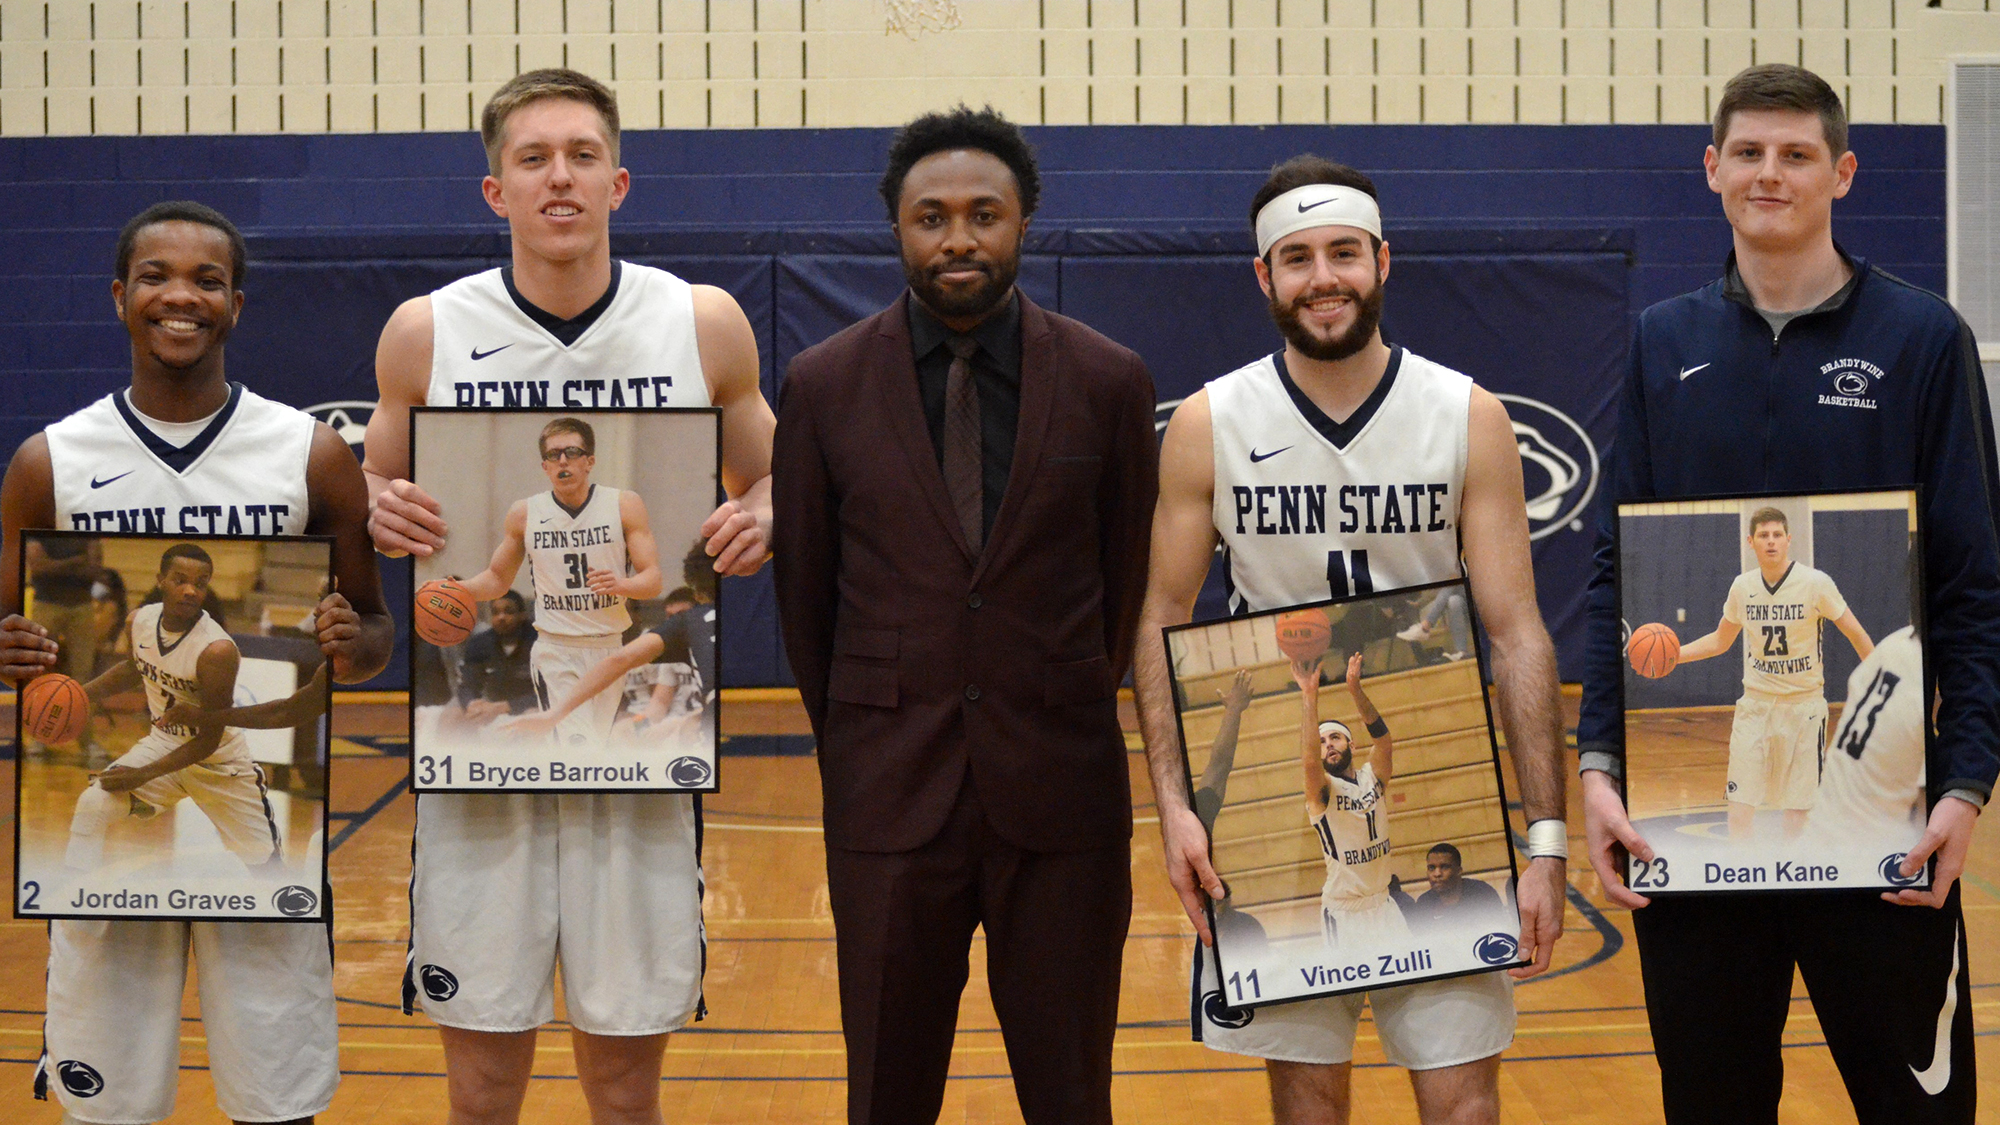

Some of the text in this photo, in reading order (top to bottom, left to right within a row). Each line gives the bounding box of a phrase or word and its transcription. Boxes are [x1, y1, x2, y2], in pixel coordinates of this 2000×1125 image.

[1820, 358, 1885, 380] BRANDYWINE
[563, 376, 673, 407] STATE
[1818, 394, 1877, 409] BASKETBALL
[179, 505, 289, 535] STATE
[1233, 483, 1448, 534] PENN STATE
[534, 525, 612, 549] PENN STATE
[564, 553, 591, 589] 31
[429, 595, 463, 618] ELITE
[543, 594, 619, 611] BRANDYWINE
[1746, 604, 1804, 620] PENN STATE
[1762, 626, 1789, 656] 23
[1837, 666, 1900, 760] 13
[419, 755, 649, 787] 31 Bryce Barrouk
[1365, 810, 1378, 841] 11
[1344, 838, 1390, 865] BRANDYW
[1632, 856, 1839, 888] 23 Dean Kane
[22, 880, 256, 910] 2 Jordan Graves
[1228, 949, 1433, 1001] 11 Vince Zulli
